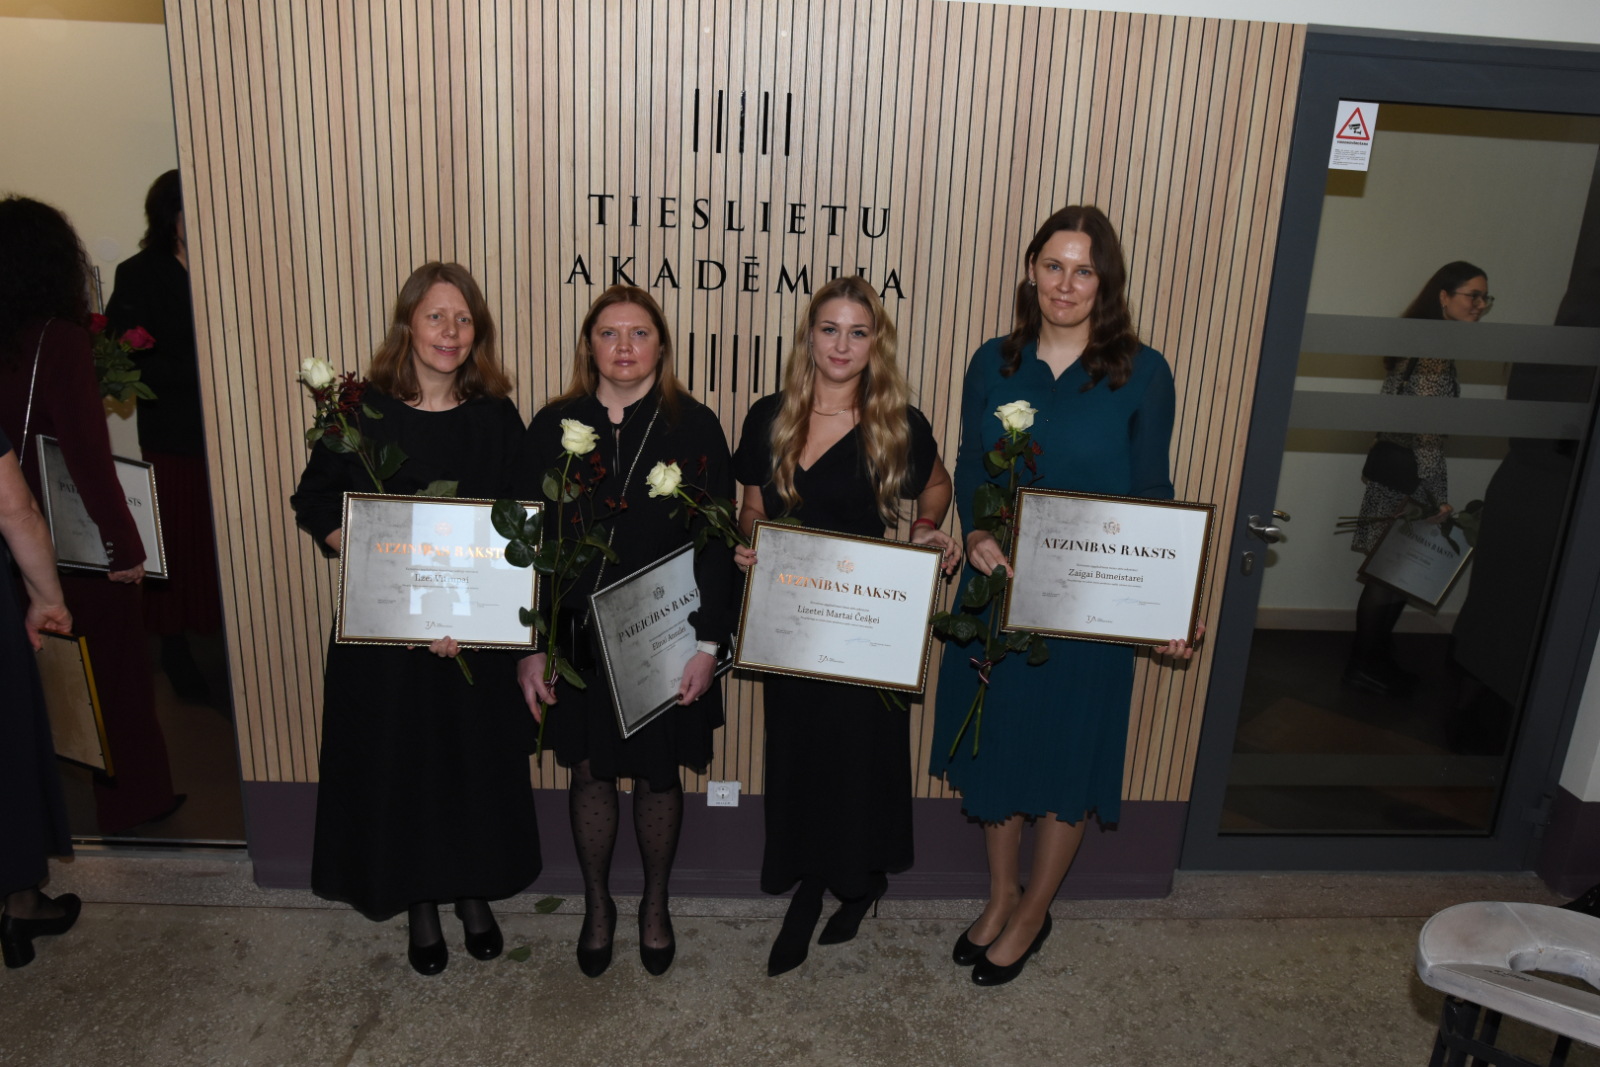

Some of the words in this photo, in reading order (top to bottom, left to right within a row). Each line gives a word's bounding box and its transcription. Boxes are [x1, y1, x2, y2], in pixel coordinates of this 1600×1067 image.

[587, 194, 889, 239] TIESLIETU
[374, 542, 450, 557] ATZINĪBAS
[454, 545, 507, 559] RAKST
[1040, 537, 1117, 554] ATZINĪBAS
[1120, 544, 1176, 560] RAKSTS
[1068, 568, 1094, 580] Zaigai
[775, 572, 850, 593] ATZINĪBAS
[853, 584, 907, 602] RAKSTS
[618, 604, 671, 643] PATEICĪBAS
[797, 605, 824, 617] Lizetei
[825, 608, 853, 620] Martai
